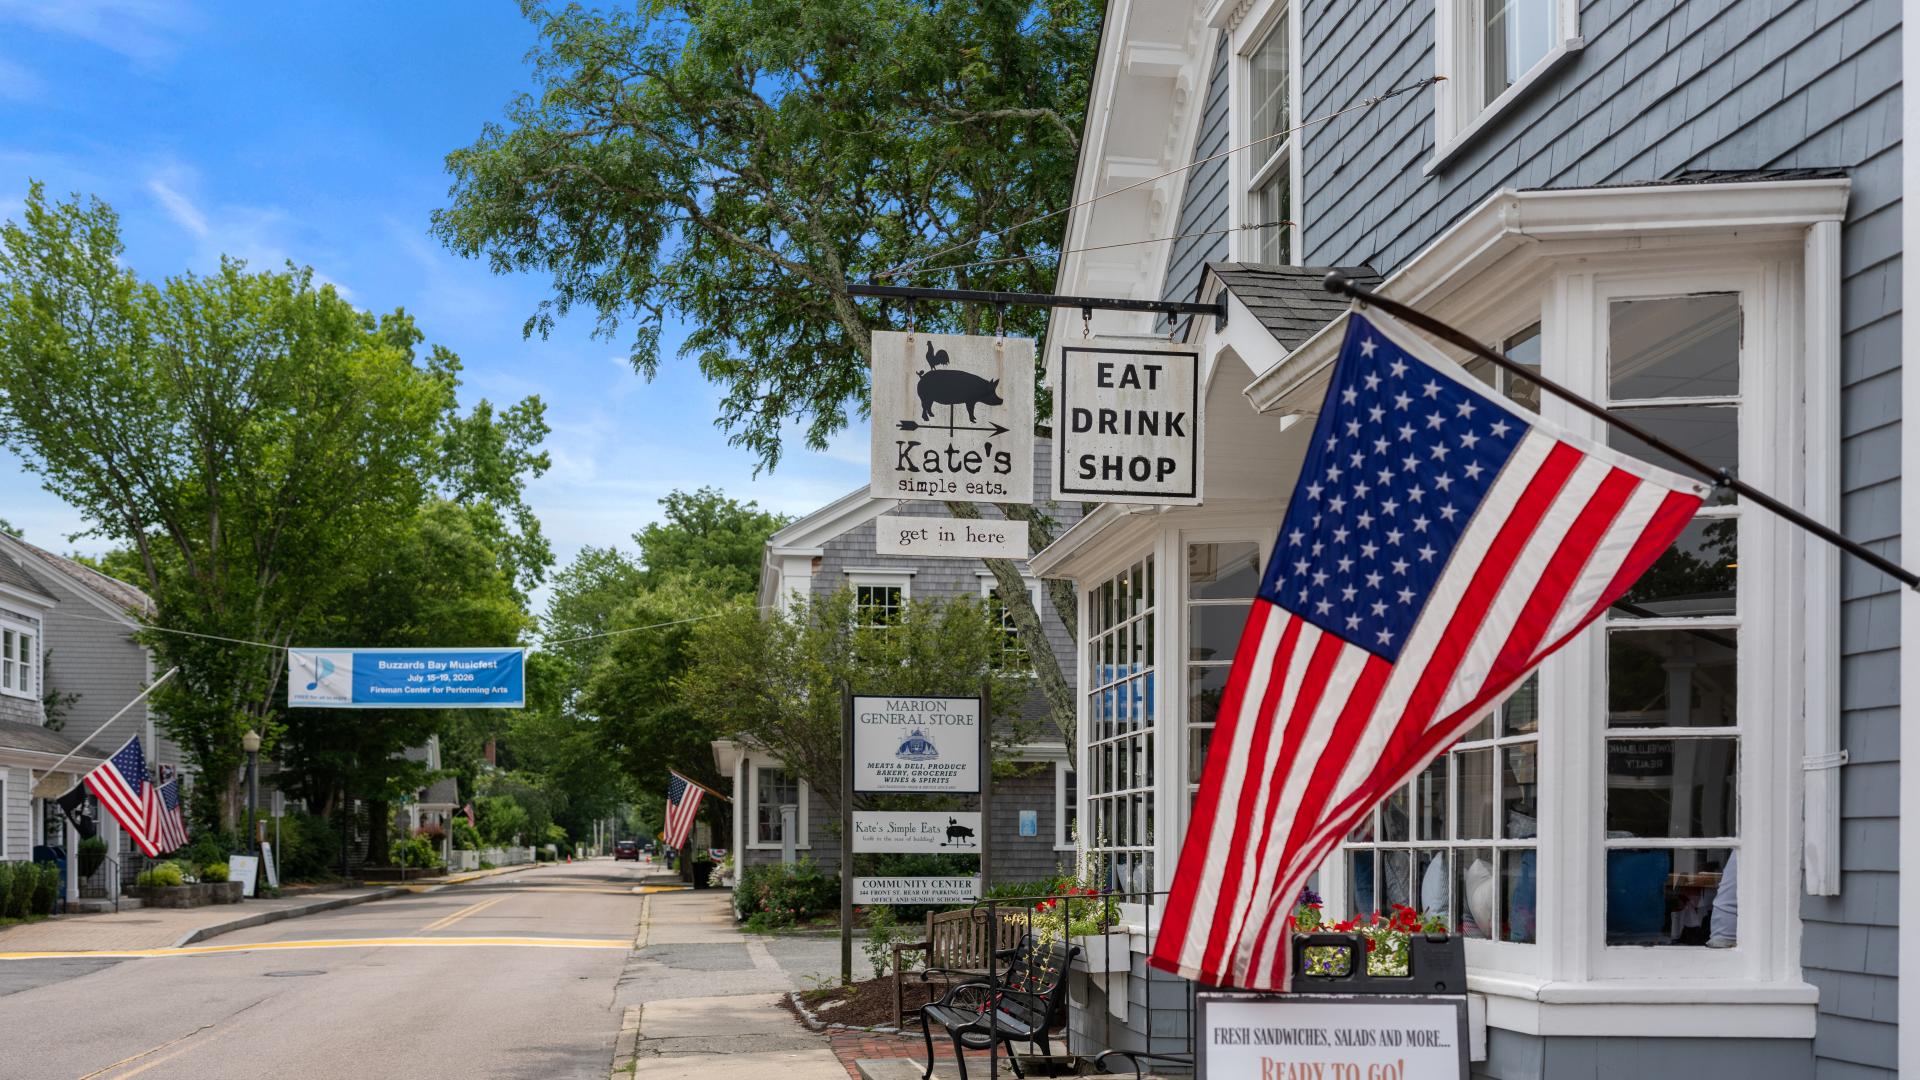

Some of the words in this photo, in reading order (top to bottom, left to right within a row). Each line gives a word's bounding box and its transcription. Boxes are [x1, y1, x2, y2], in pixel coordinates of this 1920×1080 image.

[1097, 363, 1162, 390] EAT
[1072, 408, 1186, 438] DRINK
[895, 441, 1012, 475] Kate's
[1079, 454, 1177, 483] SHOP
[898, 479, 957, 494] simple
[966, 482, 1008, 496] eats.
[899, 528, 929, 546] get
[939, 526, 956, 542] in
[966, 526, 1006, 543] here
[378, 660, 425, 670] Buzzards
[428, 661, 447, 672] Bay
[449, 661, 497, 670] Musicfest
[407, 674, 424, 684] July
[370, 687, 402, 695] Fireman
[404, 687, 430, 695] Center
[432, 687, 444, 695] for
[446, 687, 490, 696] Performing
[492, 687, 509, 695] Arts
[886, 700, 947, 712] MARION
[860, 712, 925, 725] GENERAL
[929, 714, 974, 726] STORE
[876, 770, 909, 778] BAKERY,
[911, 770, 958, 778] GROCERIES
[904, 763, 926, 771] DELI,
[855, 822, 883, 834] Kate's
[887, 822, 917, 837] Simple
[921, 822, 941, 834] Eats
[862, 880, 928, 888] COMMUNITY
[931, 880, 972, 888] CENTER
[1214, 1027, 1251, 1045] FRESH
[1254, 1027, 1331, 1047] SANDWICHES,
[1334, 1029, 1376, 1046] SALADS
[1379, 1030, 1402, 1046] AND
[1406, 1030, 1451, 1047] MORE...
[1260, 1056, 1325, 1080] READY
[1331, 1063, 1360, 1080] TO
[1368, 1058, 1405, 1080] GO!
